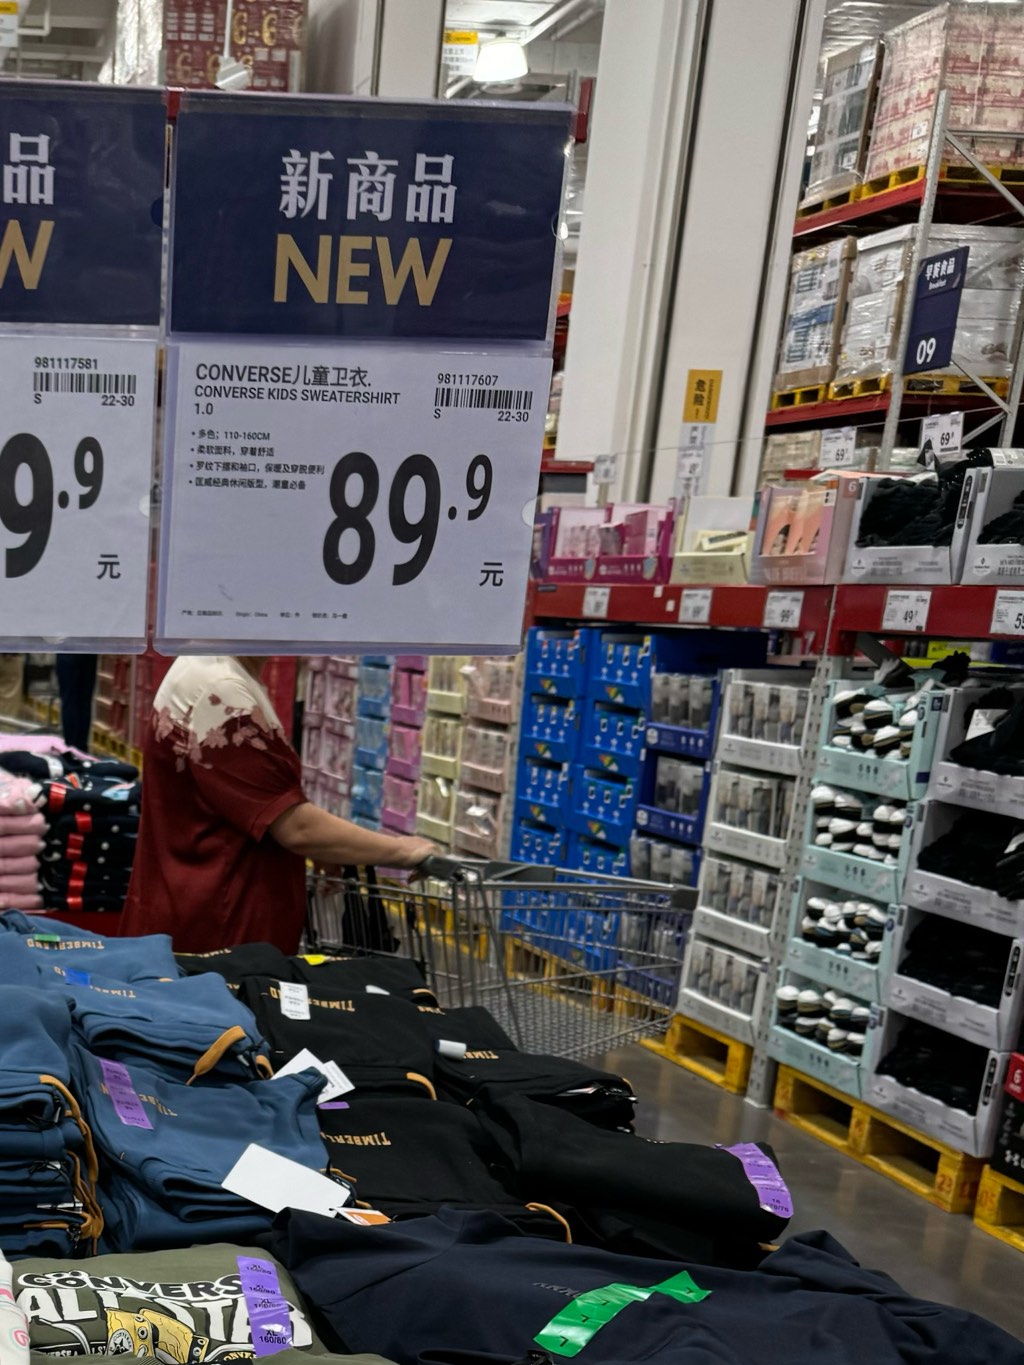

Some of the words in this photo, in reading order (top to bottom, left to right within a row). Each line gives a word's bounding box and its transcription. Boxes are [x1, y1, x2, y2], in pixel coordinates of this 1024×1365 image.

[279, 148, 458, 224] 新商品
[273, 233, 453, 307] NEW
[916, 337, 936, 365] 09
[34, 356, 98, 370] 981117581
[437, 372, 499, 387] 981117607
[34, 393, 43, 405] S
[101, 394, 136, 408] 22-30
[194, 384, 265, 402] CONVERSE
[267, 387, 298, 402] KIDS
[301, 388, 401, 406] SWEATERSHIRT
[193, 401, 214, 416] 1.0
[433, 408, 442, 420] S
[497, 409, 530, 423] 22-30
[322, 451, 494, 587] 89.9
[96, 553, 122, 580] 元
[478, 561, 505, 588] 元
[258, 1335, 287, 1345] 160/80
